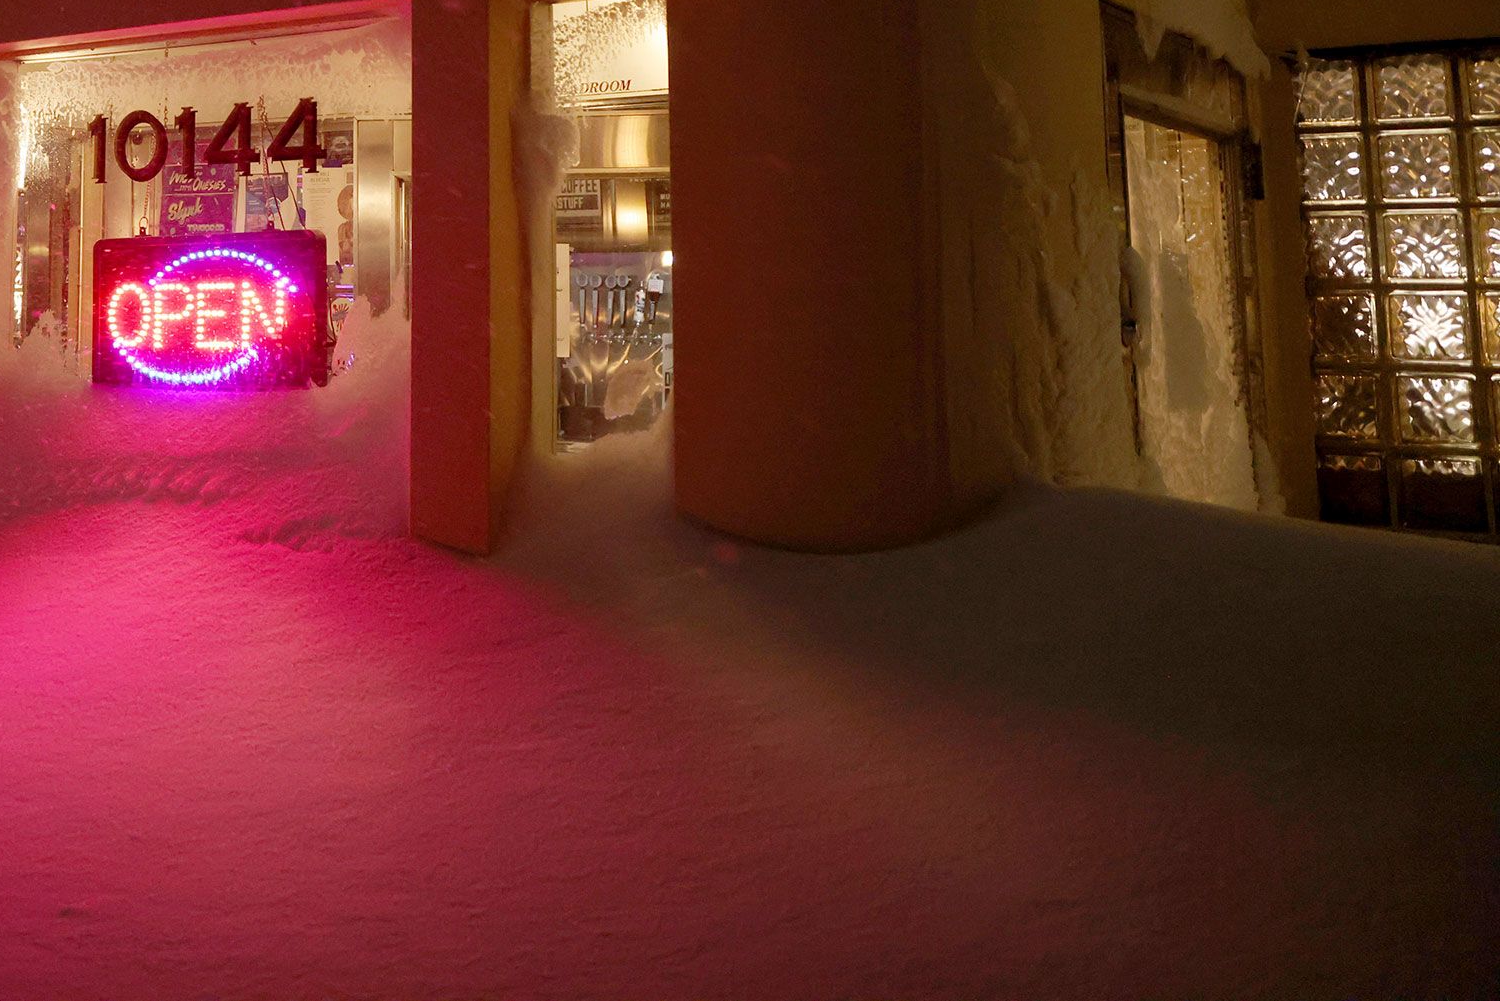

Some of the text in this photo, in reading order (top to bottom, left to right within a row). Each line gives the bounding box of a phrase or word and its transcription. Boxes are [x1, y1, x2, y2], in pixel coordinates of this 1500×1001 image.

[87, 96, 328, 184] 10144
[556, 196, 584, 210] STUFF
[108, 281, 287, 348] OPEN
